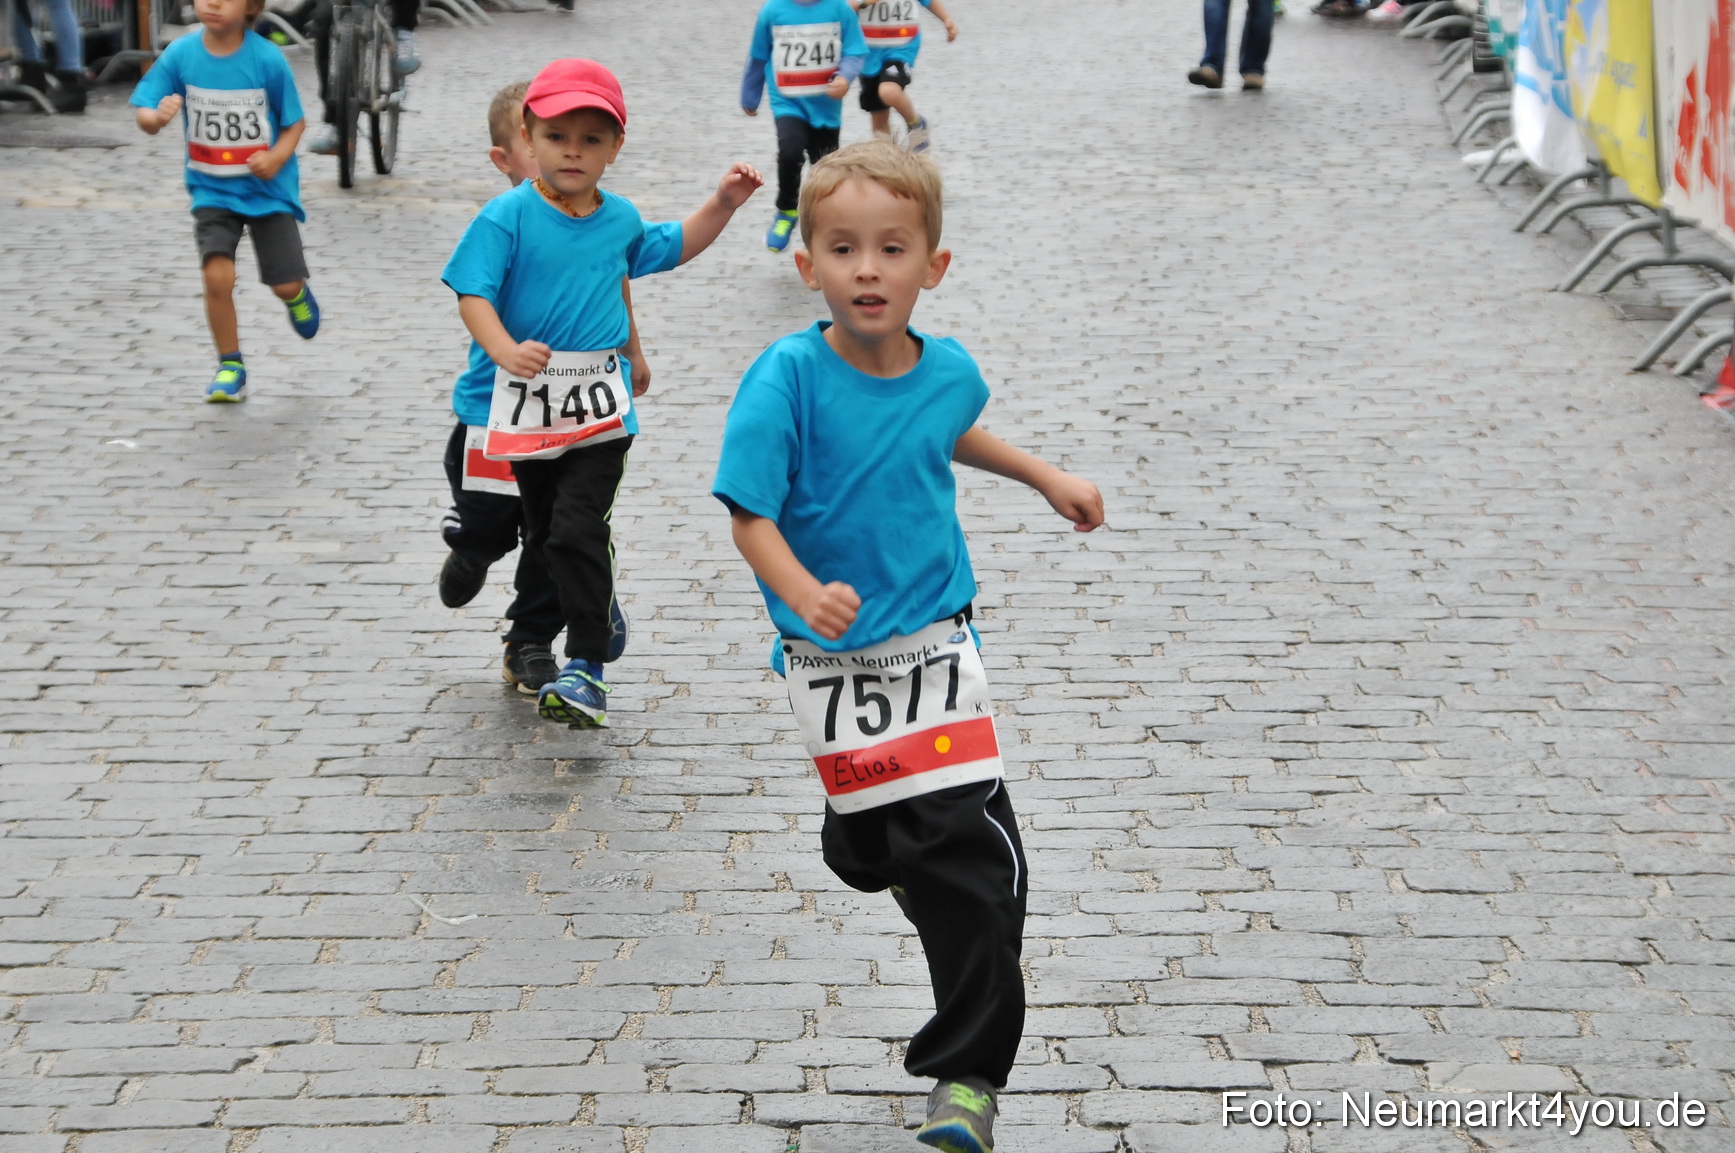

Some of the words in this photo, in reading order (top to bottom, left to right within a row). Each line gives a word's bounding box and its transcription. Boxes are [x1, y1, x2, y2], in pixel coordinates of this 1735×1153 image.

[867, 1, 914, 22] 7042
[780, 40, 835, 67] 7244
[193, 108, 261, 141] 7583
[539, 364, 600, 377] Neumarkt
[508, 381, 617, 427] 7140
[851, 645, 939, 669] Neumarkt
[808, 652, 961, 742] 7577
[834, 754, 900, 787] Elias
